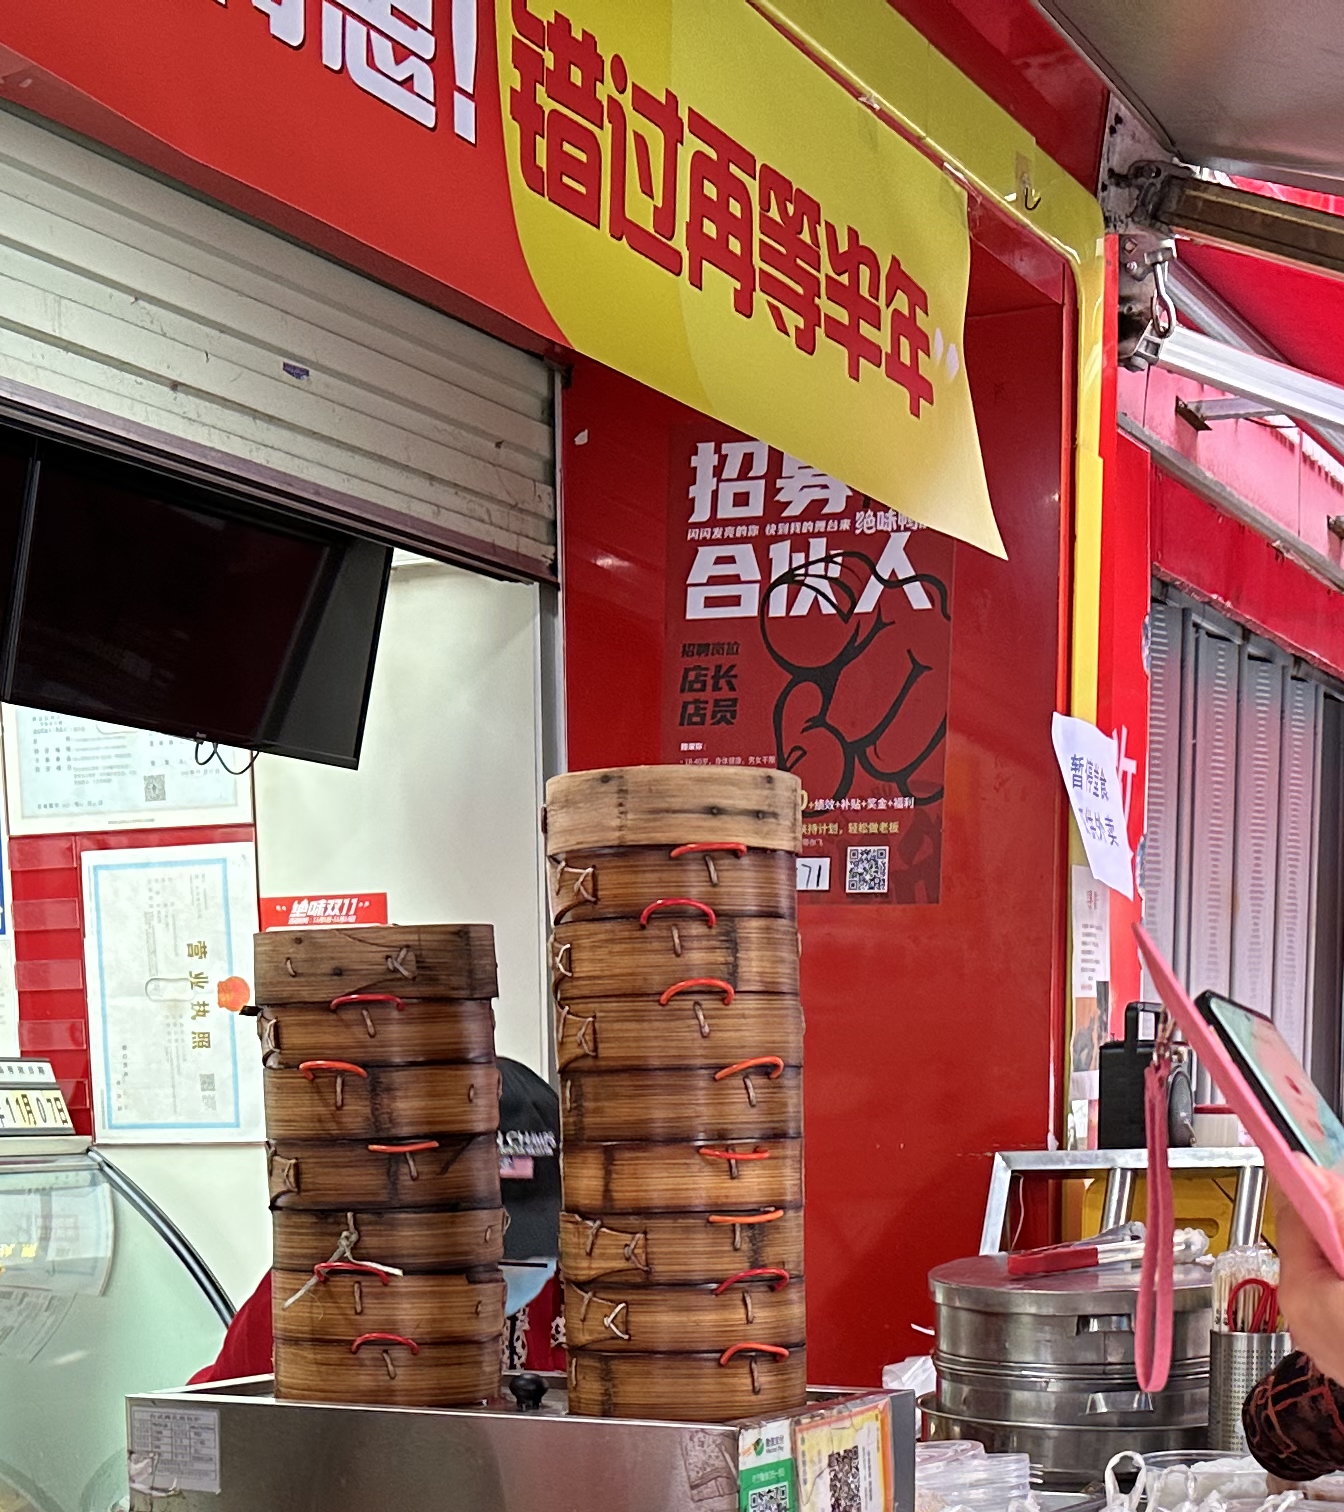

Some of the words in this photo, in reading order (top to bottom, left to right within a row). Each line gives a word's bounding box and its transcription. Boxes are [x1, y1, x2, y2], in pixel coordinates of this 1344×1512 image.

[510, 0, 934, 419] 错过再等半年
[685, 531, 933, 620] 合伙人
[679, 664, 738, 693] 店长
[678, 697, 739, 726] 店员
